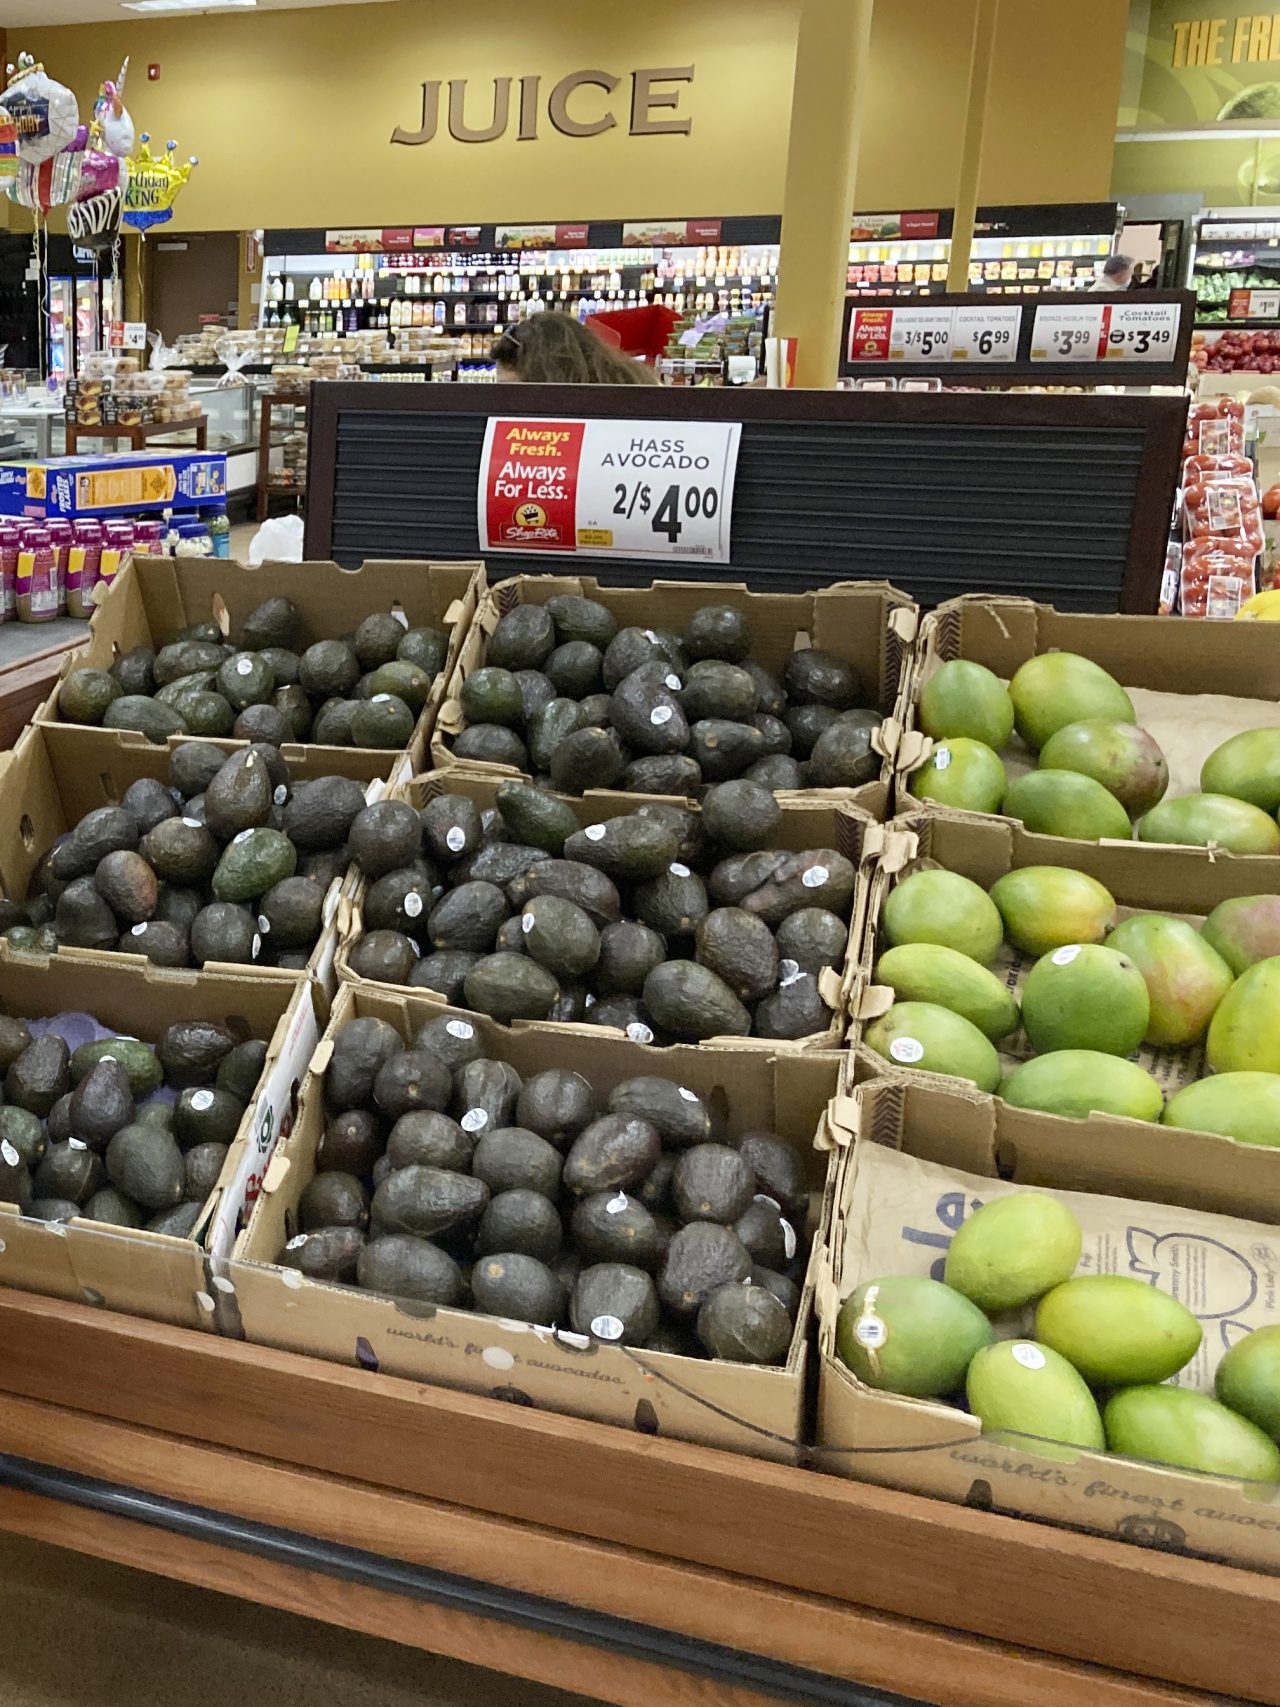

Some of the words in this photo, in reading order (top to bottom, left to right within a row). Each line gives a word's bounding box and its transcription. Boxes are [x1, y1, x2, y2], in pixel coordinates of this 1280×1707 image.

[1171, 19, 1227, 68] THE
[390, 63, 694, 145] JUICE
[129, 171, 169, 190] rthday
[859, 324, 887, 333] Always
[506, 428, 570, 442] Always
[509, 443, 562, 457] Fresh.
[630, 438, 685, 453] HASS
[601, 453, 710, 470] AVOCADO
[499, 461, 567, 481] Always
[494, 480, 523, 498] For
[527, 482, 569, 500] Less.
[505, 526, 559, 540] ShopRite
[949, 1449, 1069, 1487] world's
[1083, 1480, 1186, 1511] finest
